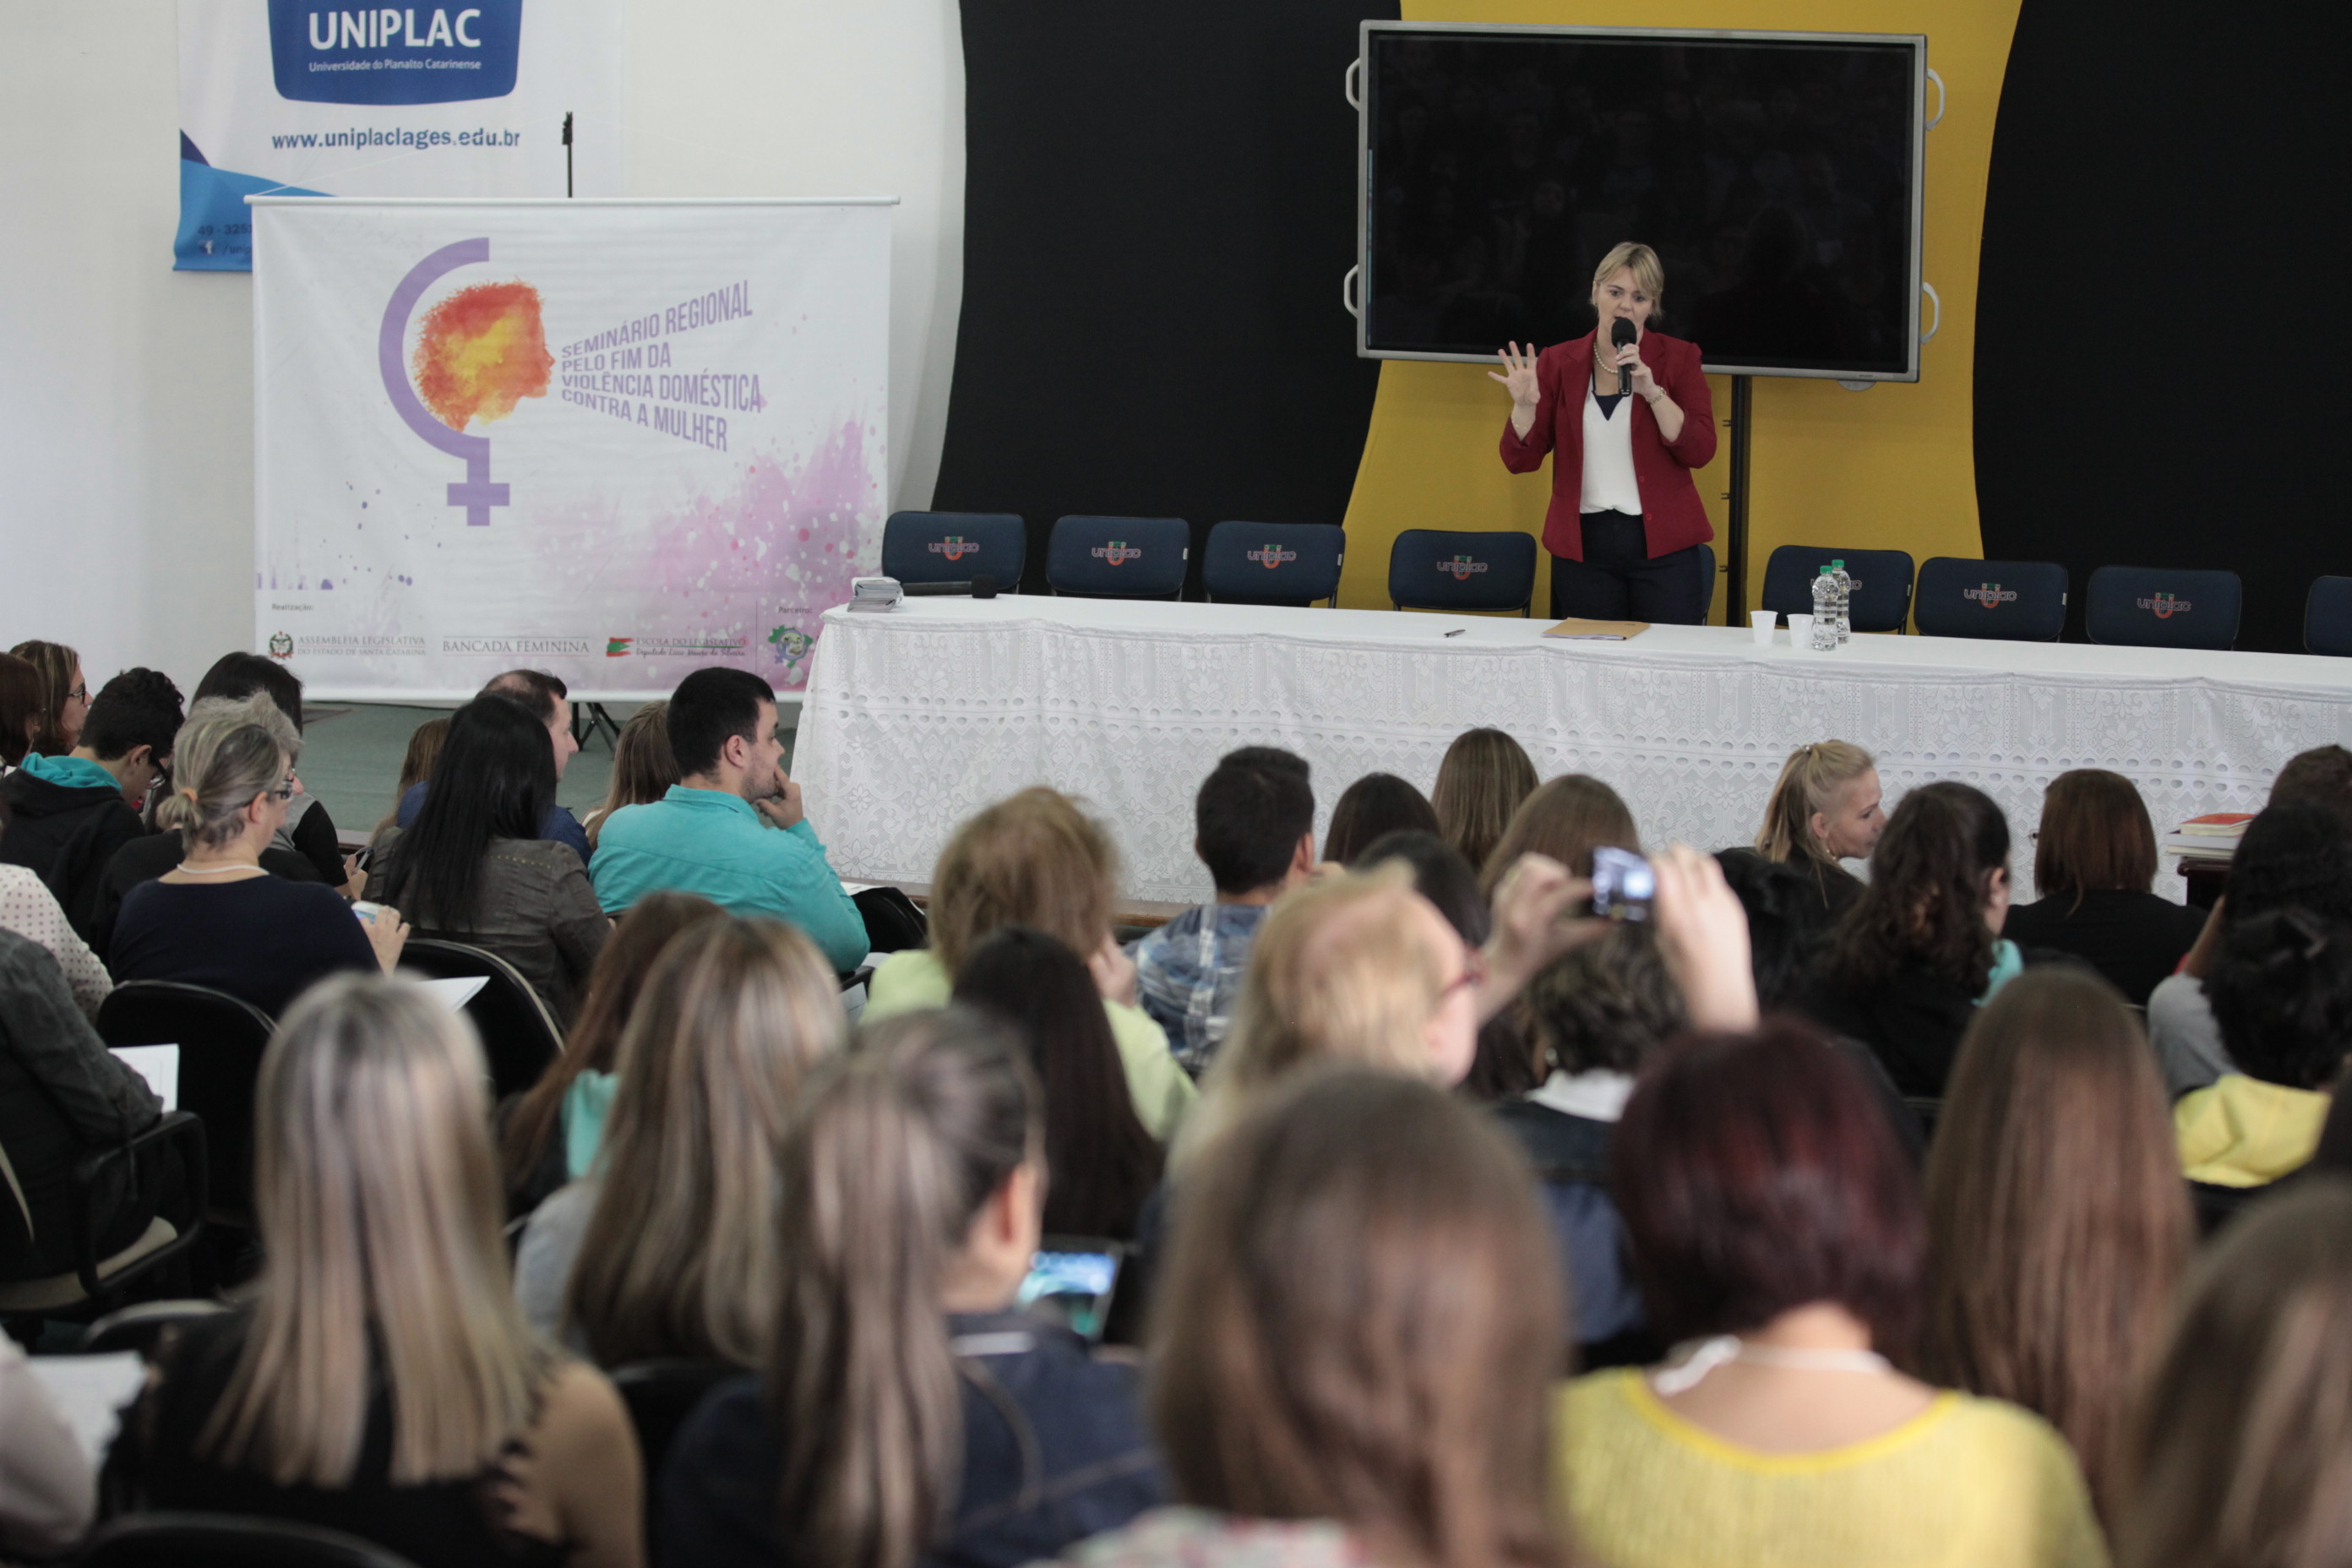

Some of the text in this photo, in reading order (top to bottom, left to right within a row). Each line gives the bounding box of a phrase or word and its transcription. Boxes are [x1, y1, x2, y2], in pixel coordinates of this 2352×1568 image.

[309, 8, 482, 50] UNIPLAC
[309, 58, 482, 72] Universidade do Planalto Catarinense
[272, 127, 520, 150] www.uniplaclages.edu.br
[198, 225, 214, 235] 49
[562, 280, 753, 358] SEMINÁRIO REGIONAL
[562, 342, 672, 373] PELO FIM DA
[562, 368, 761, 413] VIOLÊNCIA DOMÉSTICA
[562, 389, 727, 452] CONTRA A MULHER
[271, 603, 314, 612] Realização:
[298, 635, 426, 645] ASSEMBLEIA LEGISLATIVA
[443, 640, 590, 653] BANCADA FEMININA
[689, 638, 746, 646] LEGISLATIVO
[385, 648, 426, 656] CATARINA
